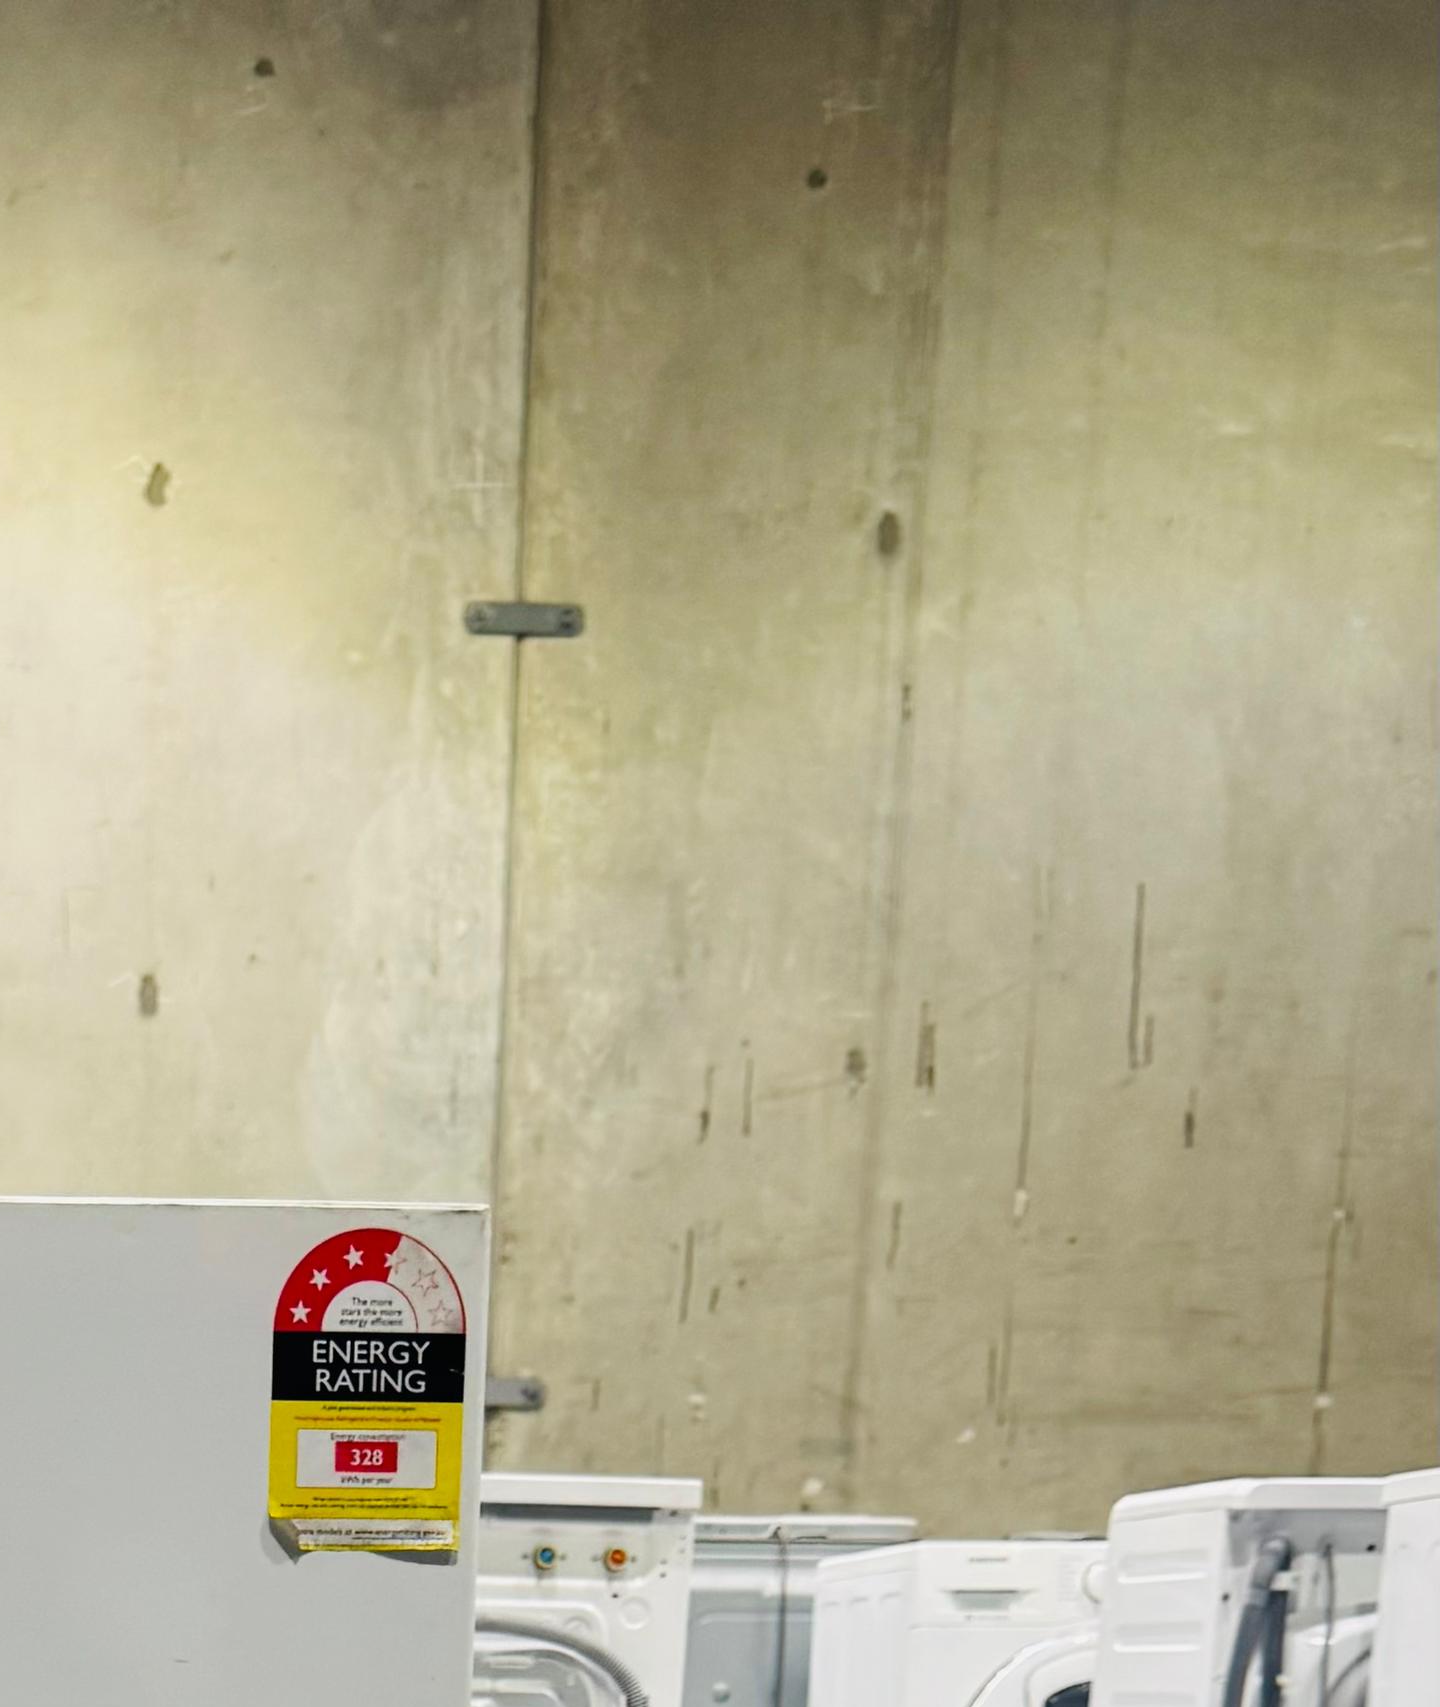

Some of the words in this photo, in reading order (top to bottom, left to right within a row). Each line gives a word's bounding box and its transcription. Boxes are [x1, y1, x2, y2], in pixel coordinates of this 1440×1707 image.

[352, 1296, 368, 1306] The
[312, 1339, 431, 1365] ENERGY
[315, 1368, 427, 1394] RATING
[349, 1448, 384, 1466] 328
